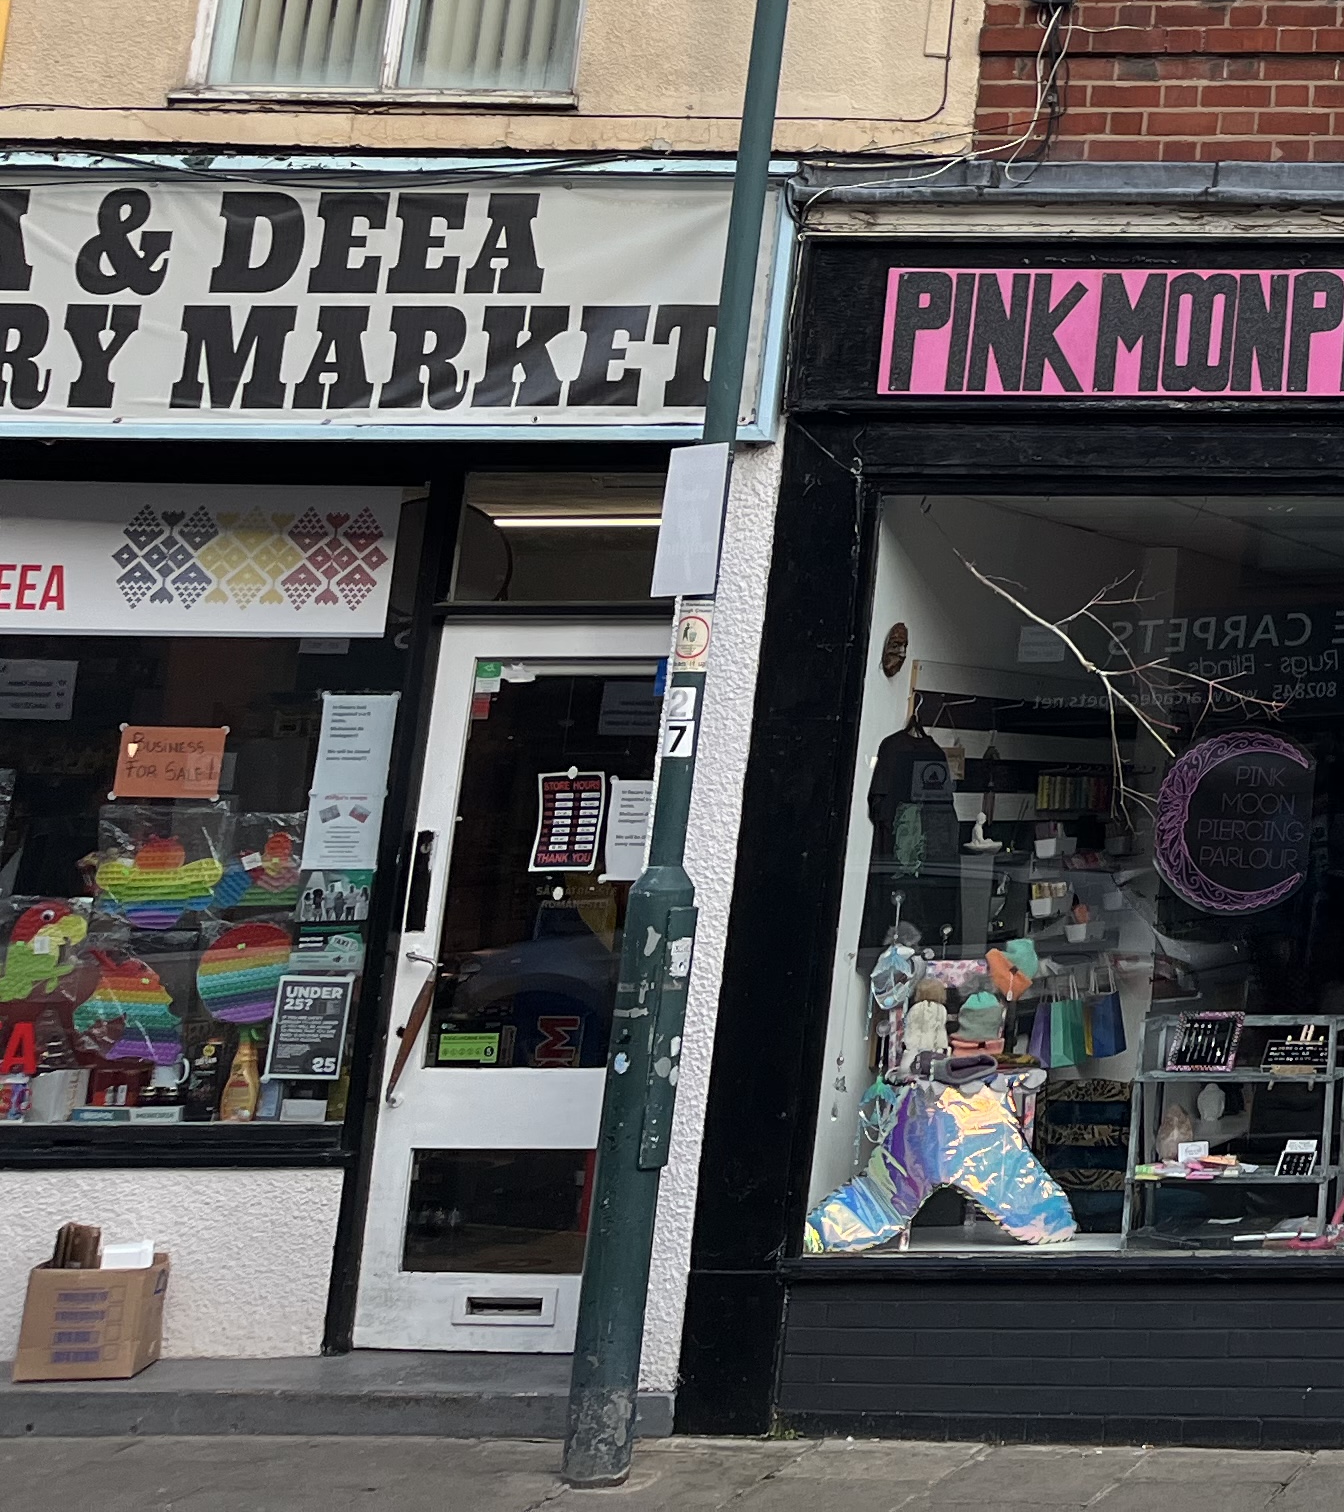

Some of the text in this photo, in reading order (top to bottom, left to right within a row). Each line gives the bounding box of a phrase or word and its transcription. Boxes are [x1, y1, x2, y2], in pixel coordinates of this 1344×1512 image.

[76, 188, 173, 296] &
[209, 191, 545, 294] DEEA
[170, 304, 720, 411] MARKET
[669, 690, 689, 717] 2
[668, 725, 687, 753] 7
[125, 759, 158, 779] FOR
[1236, 766, 1286, 787] PINK
[544, 780, 600, 791] STORE HOURS
[1222, 792, 1296, 815] MOON
[1198, 819, 1305, 843] PIERCING
[536, 852, 592, 864] THANK YOU
[1200, 846, 1299, 870] PARLOUR
[283, 998, 314, 1011] 25?
[286, 986, 343, 1000] UNDER
